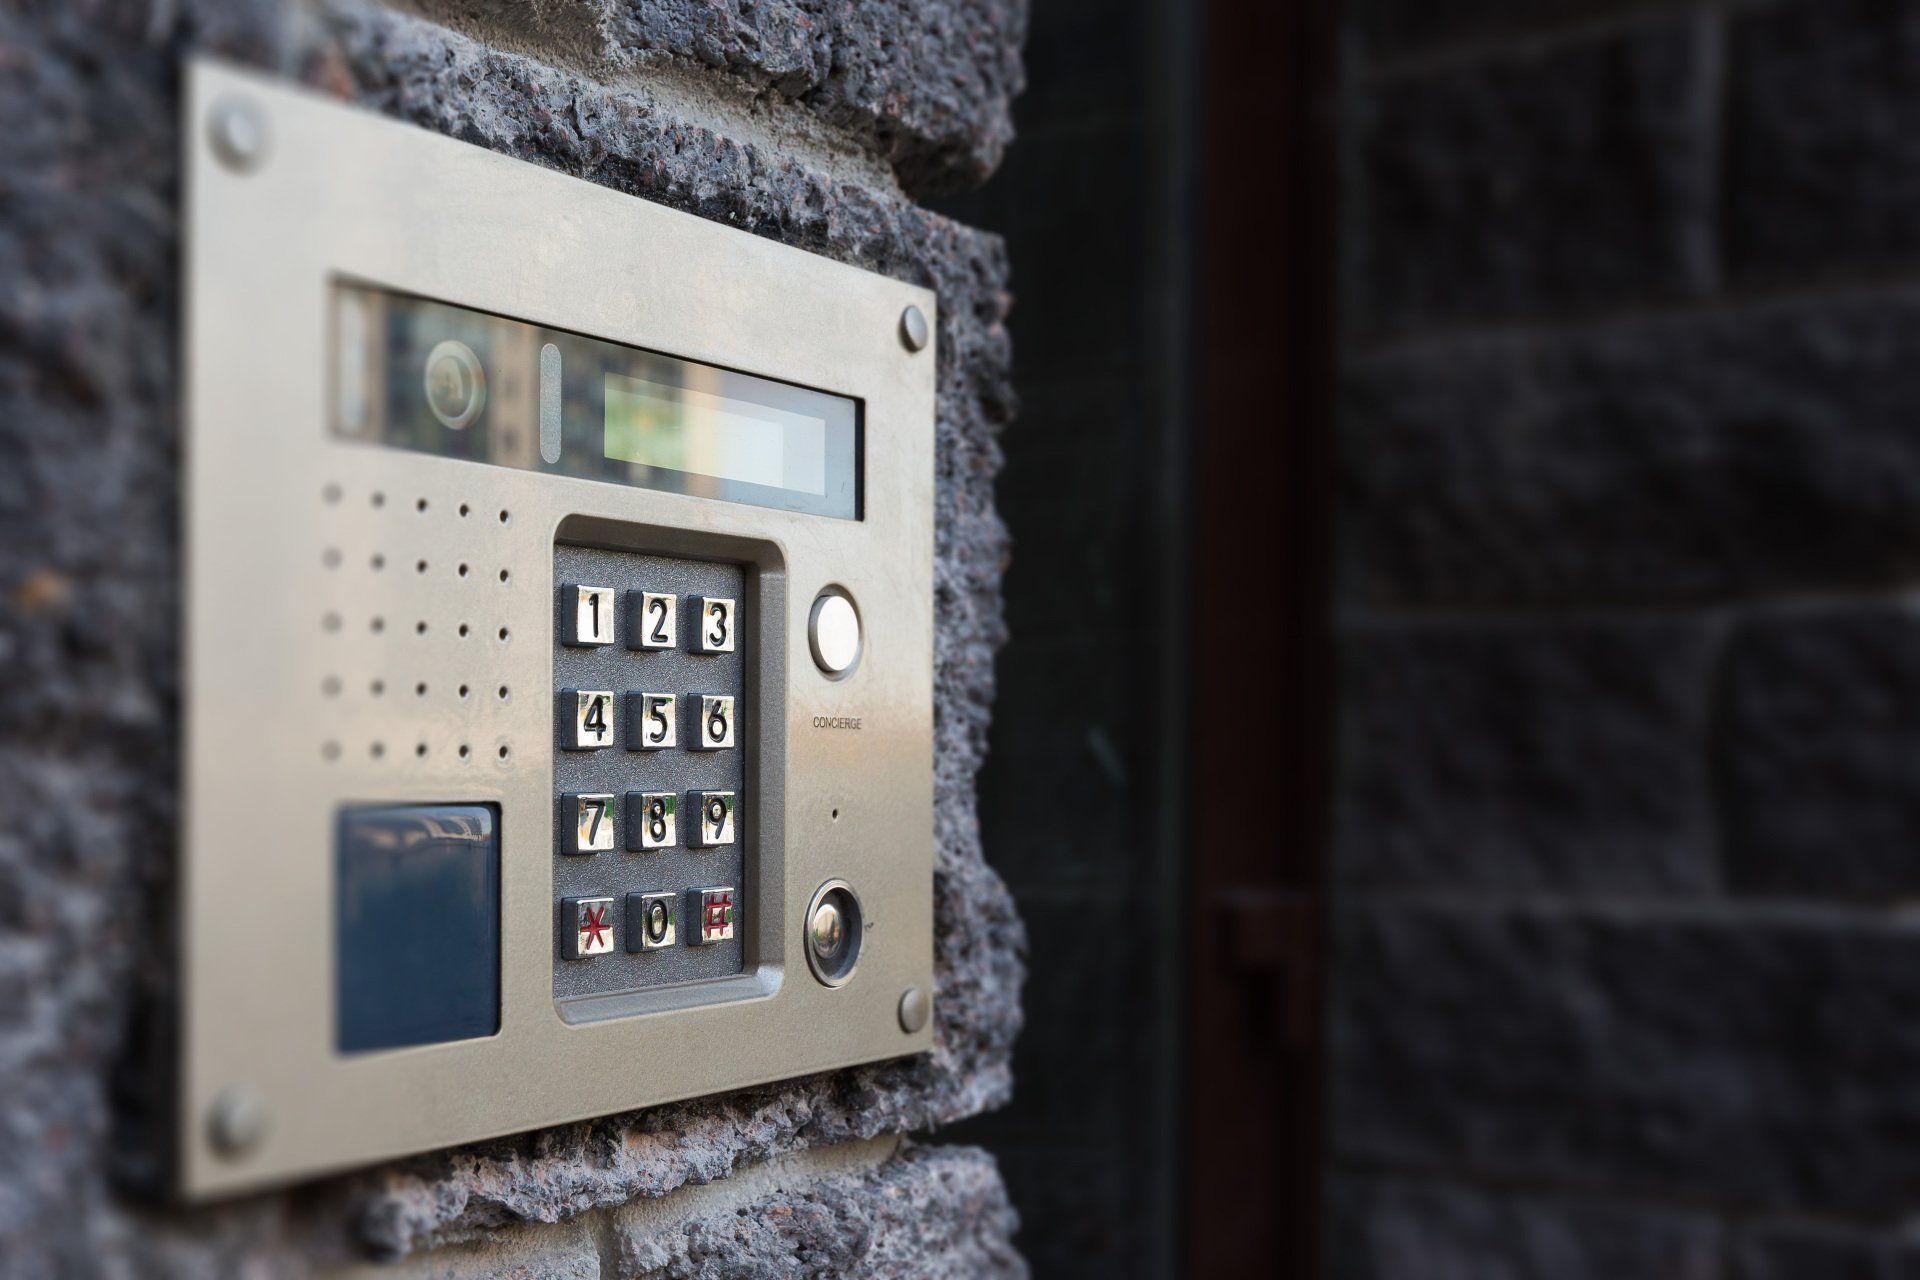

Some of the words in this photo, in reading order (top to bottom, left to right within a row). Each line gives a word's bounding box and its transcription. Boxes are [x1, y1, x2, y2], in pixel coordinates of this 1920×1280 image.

[588, 593, 600, 639] 1
[650, 598, 668, 642] 2
[709, 602, 727, 647] 3
[583, 695, 607, 741] 4
[650, 697, 668, 743] 5
[708, 699, 727, 743] 6
[813, 716, 862, 730] CONCIERGE
[585, 800, 606, 846] 7
[650, 799, 667, 842] 8
[708, 798, 727, 840] 9
[649, 900, 668, 944] 0
